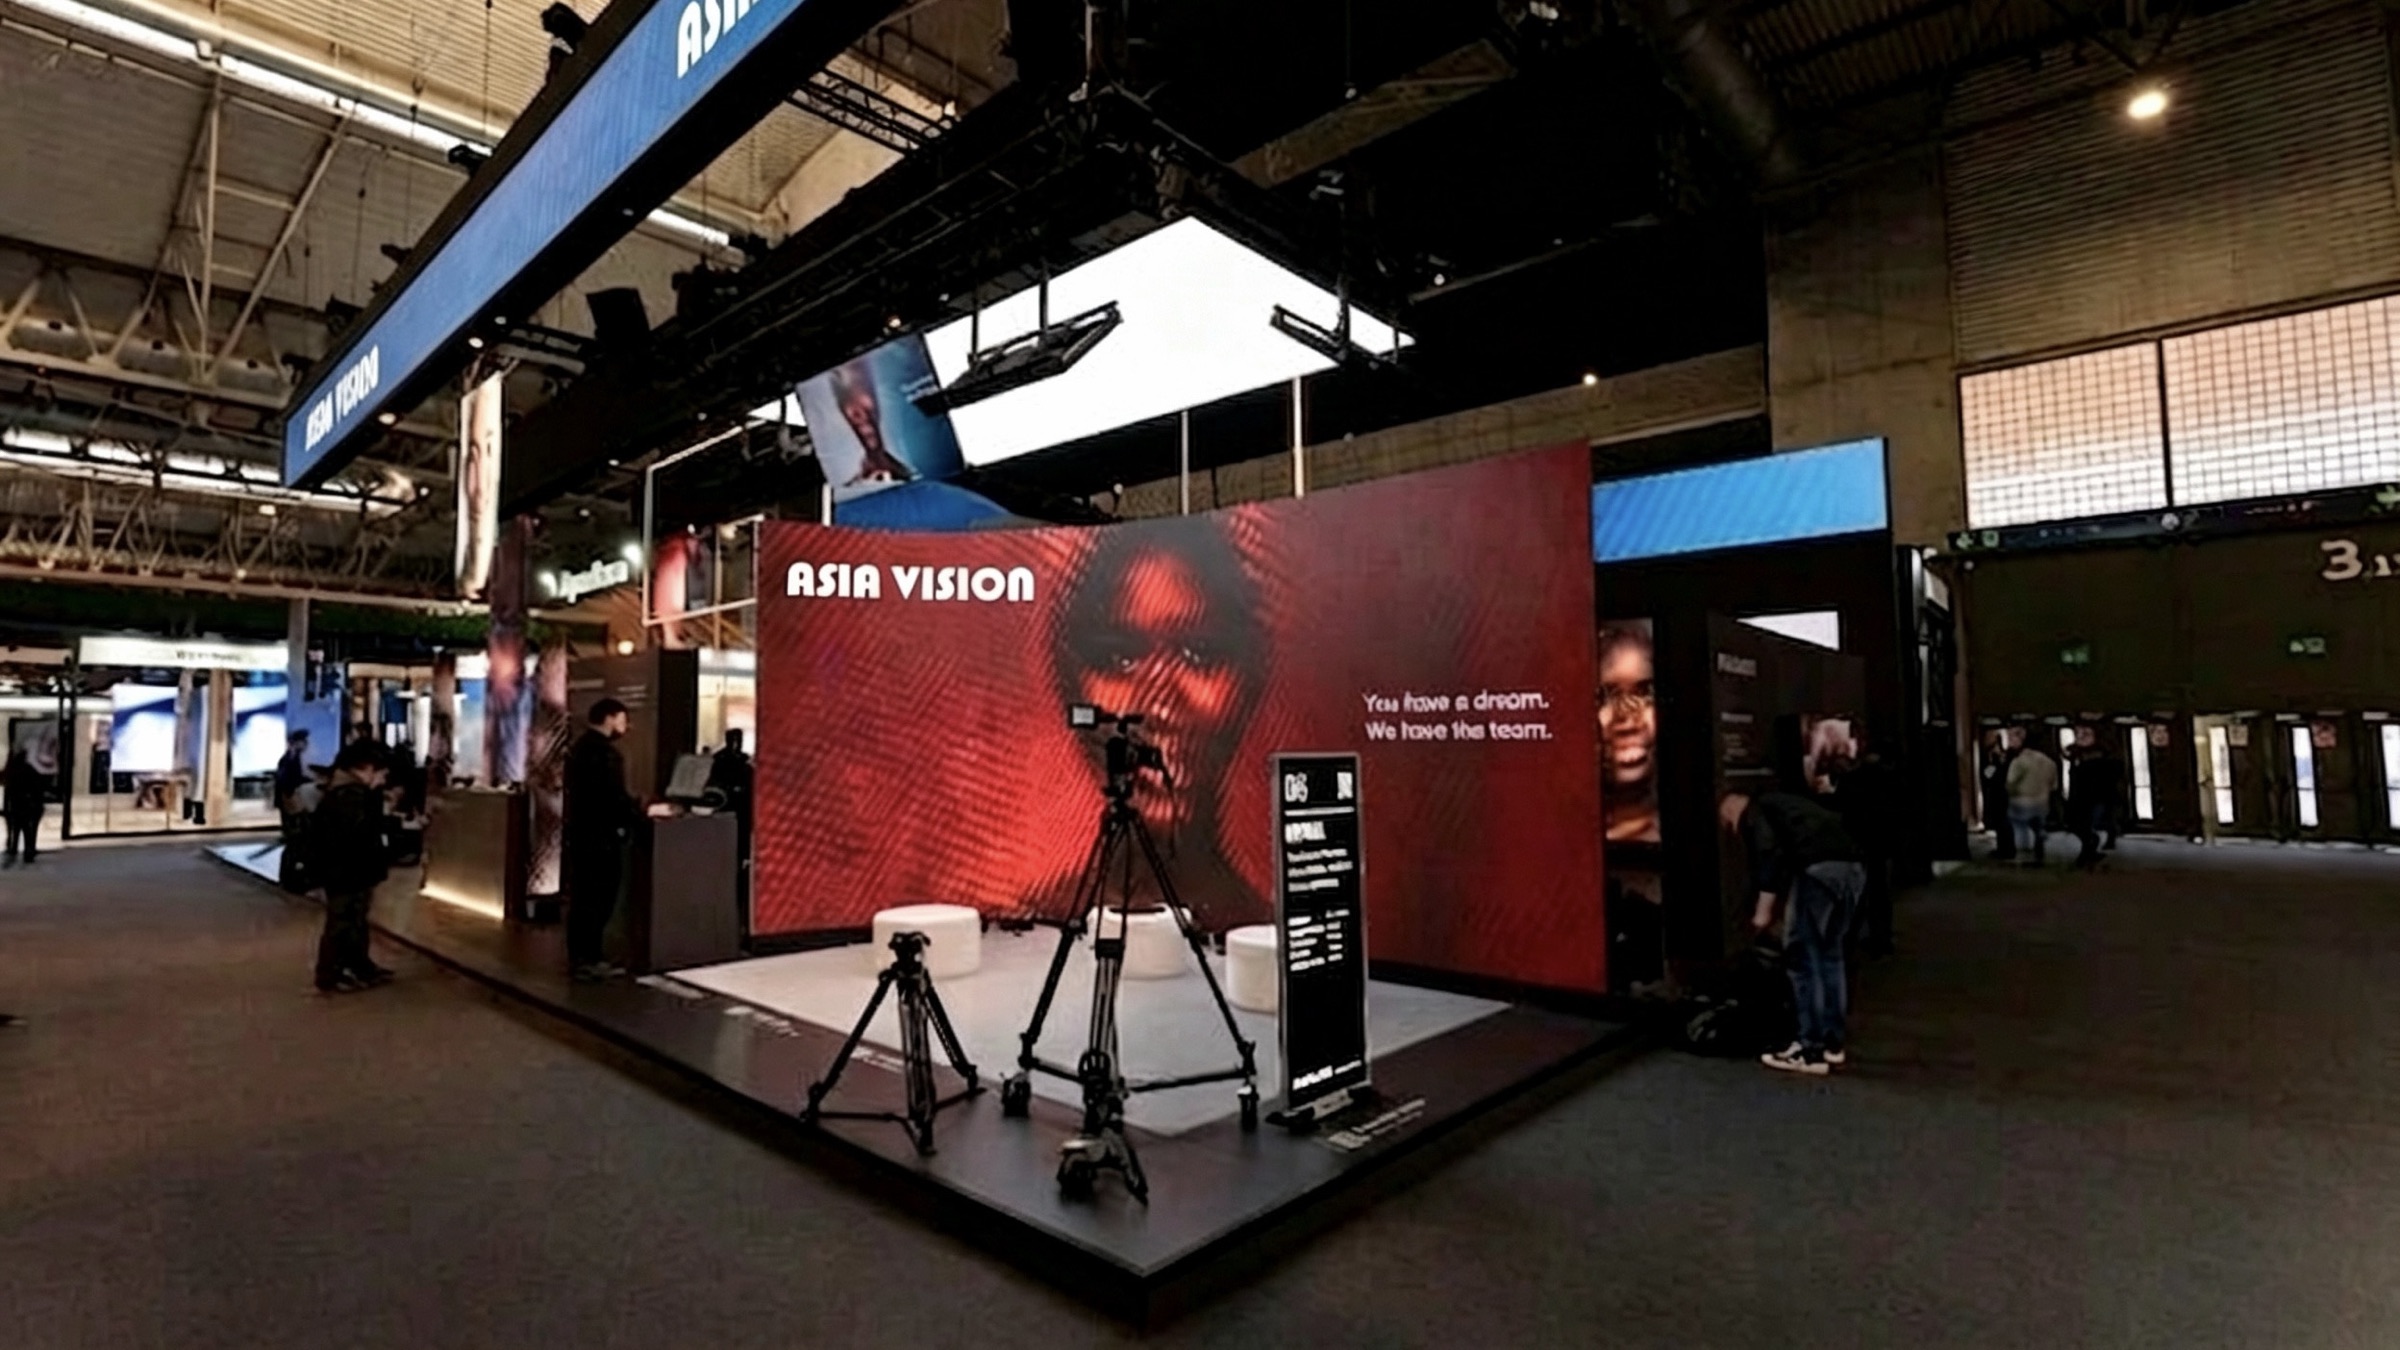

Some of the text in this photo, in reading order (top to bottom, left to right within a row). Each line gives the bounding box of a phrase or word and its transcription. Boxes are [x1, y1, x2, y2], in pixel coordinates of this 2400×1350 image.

[787, 562, 1034, 602] ASIA VISION
[1403, 690, 1450, 712] have
[1455, 695, 1469, 712] a
[1473, 689, 1550, 711] dream.
[1365, 719, 1552, 741] We have the team.
